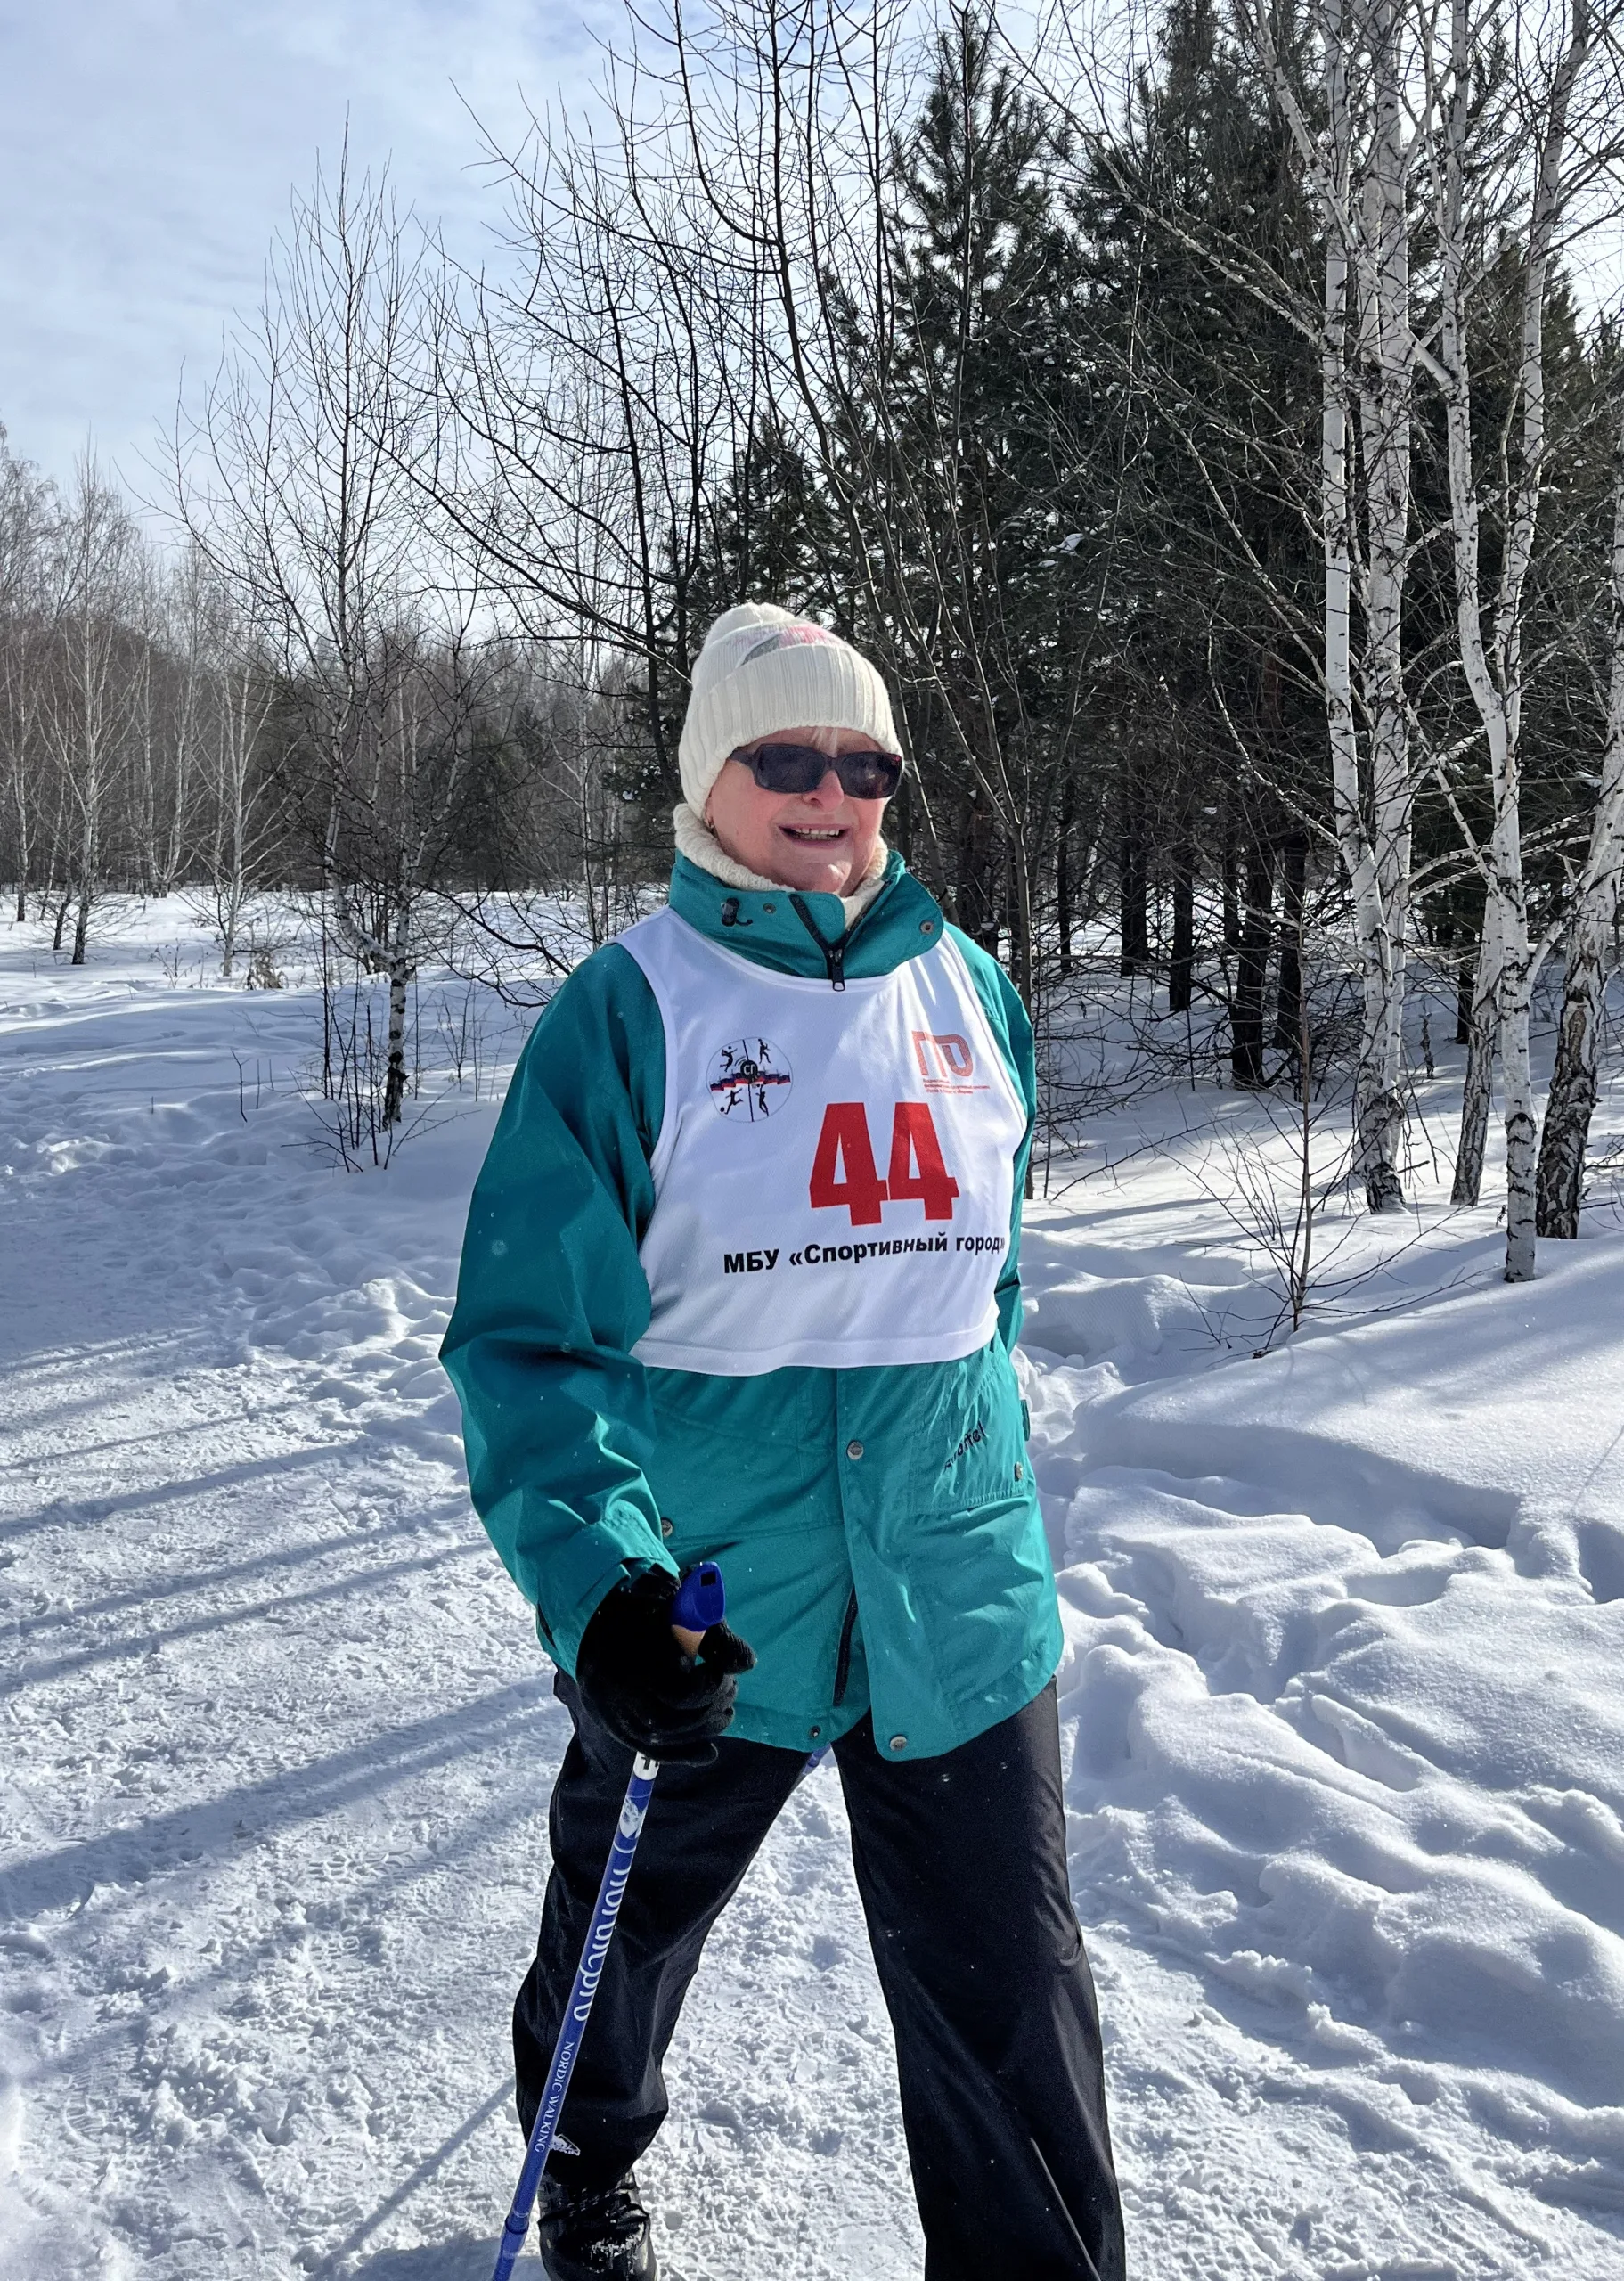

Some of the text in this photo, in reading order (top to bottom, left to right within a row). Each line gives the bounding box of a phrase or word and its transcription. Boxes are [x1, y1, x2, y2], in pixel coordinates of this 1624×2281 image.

[809, 1101, 960, 1227] 44
[723, 1248, 780, 1274] МБУ
[788, 1231, 948, 1265] «Спортивный
[535, 2040, 575, 2153] NORDIC WALKING
